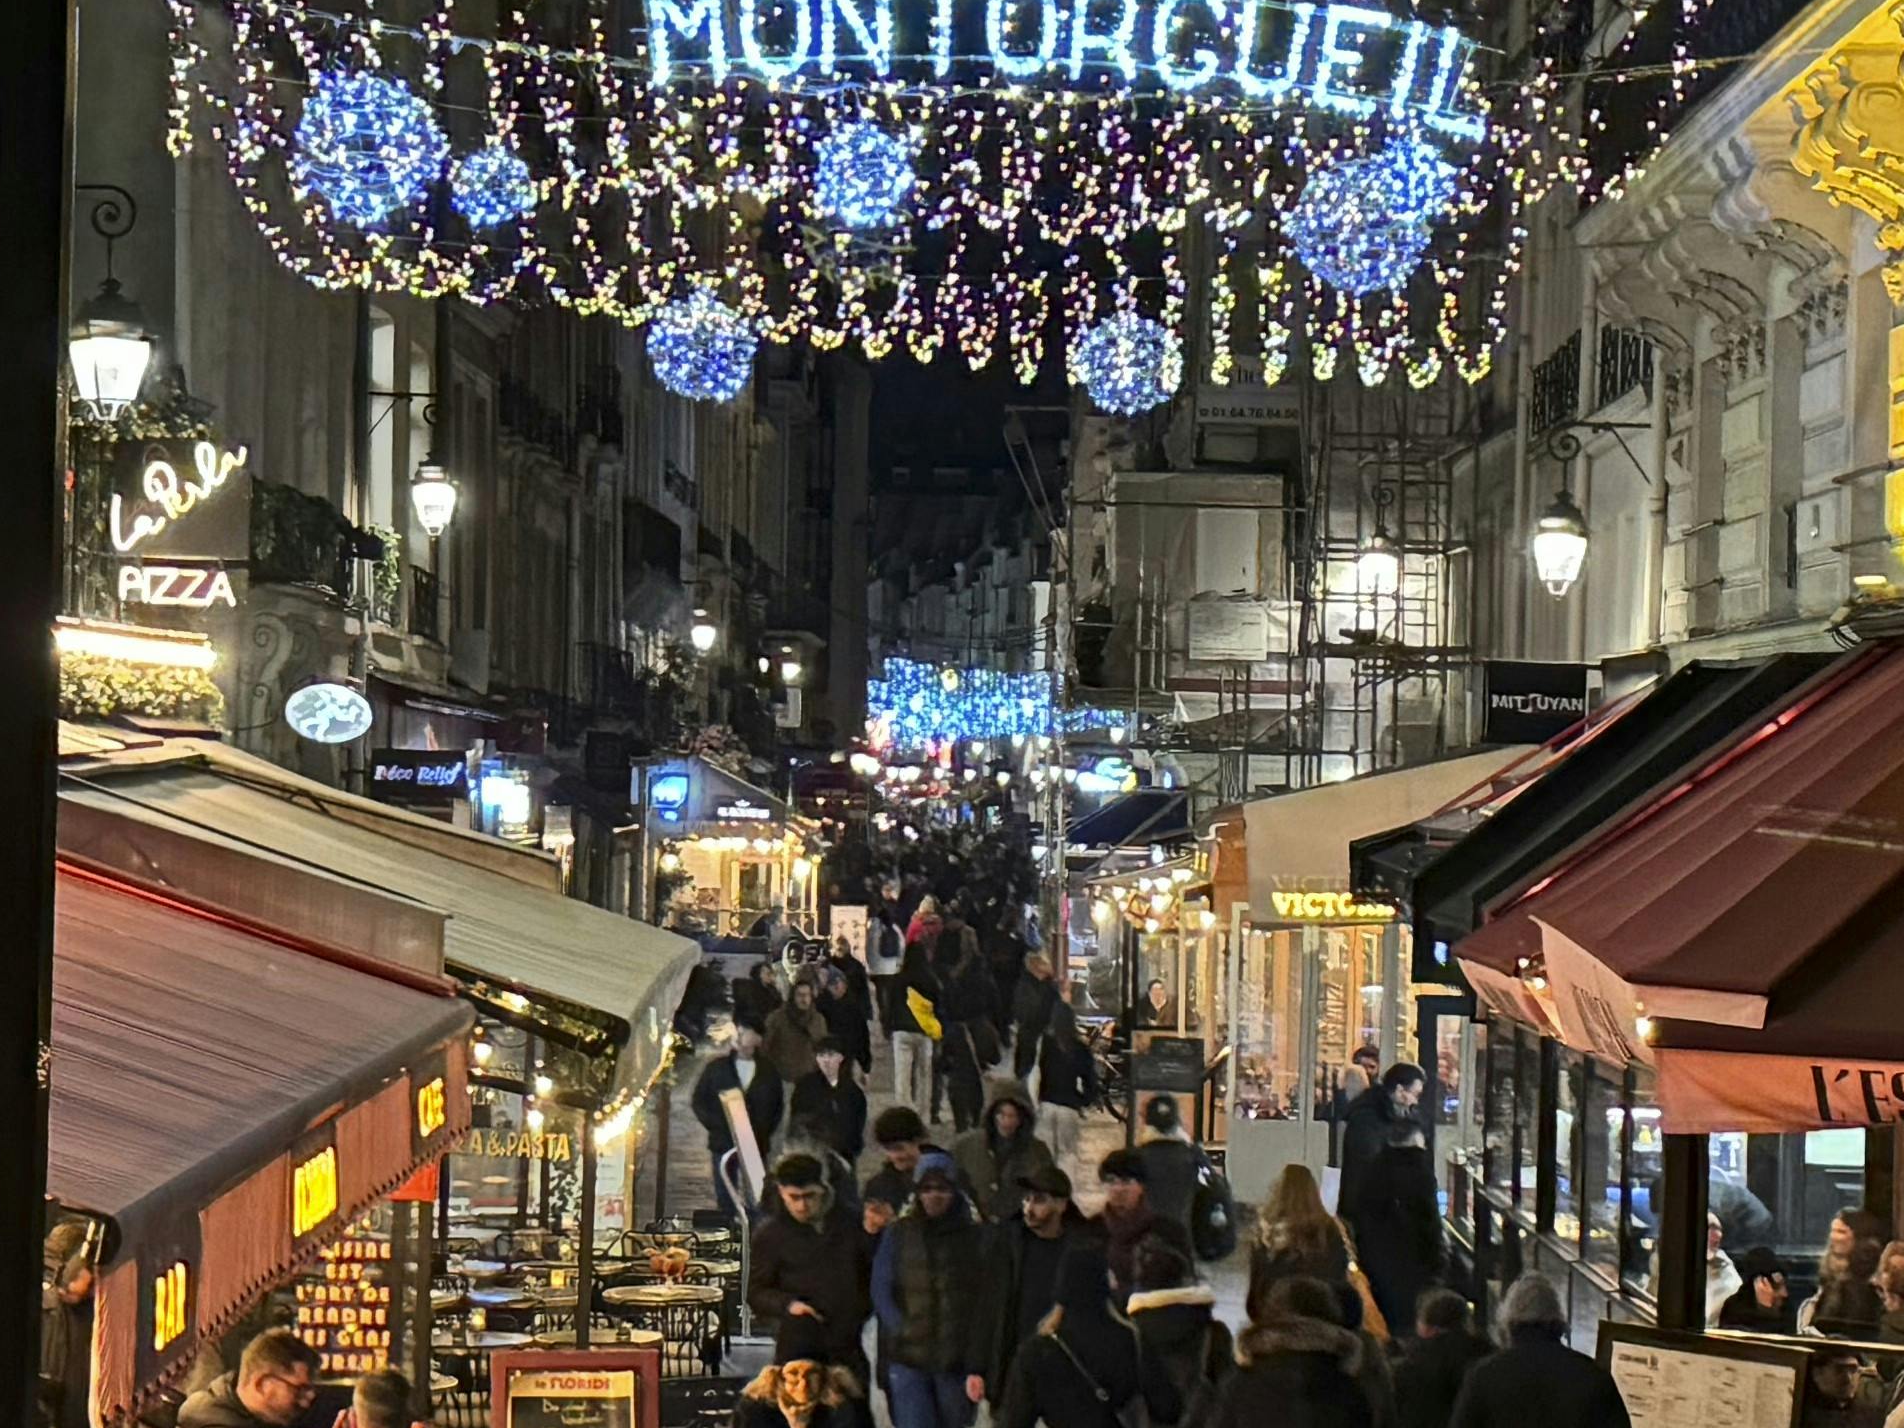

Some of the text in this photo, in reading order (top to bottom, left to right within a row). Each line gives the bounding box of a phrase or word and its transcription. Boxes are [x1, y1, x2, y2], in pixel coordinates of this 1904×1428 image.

[118, 565, 237, 607] PIZZA
[506, 1132, 570, 1161] PASTA
[325, 1263, 363, 1280] EST
